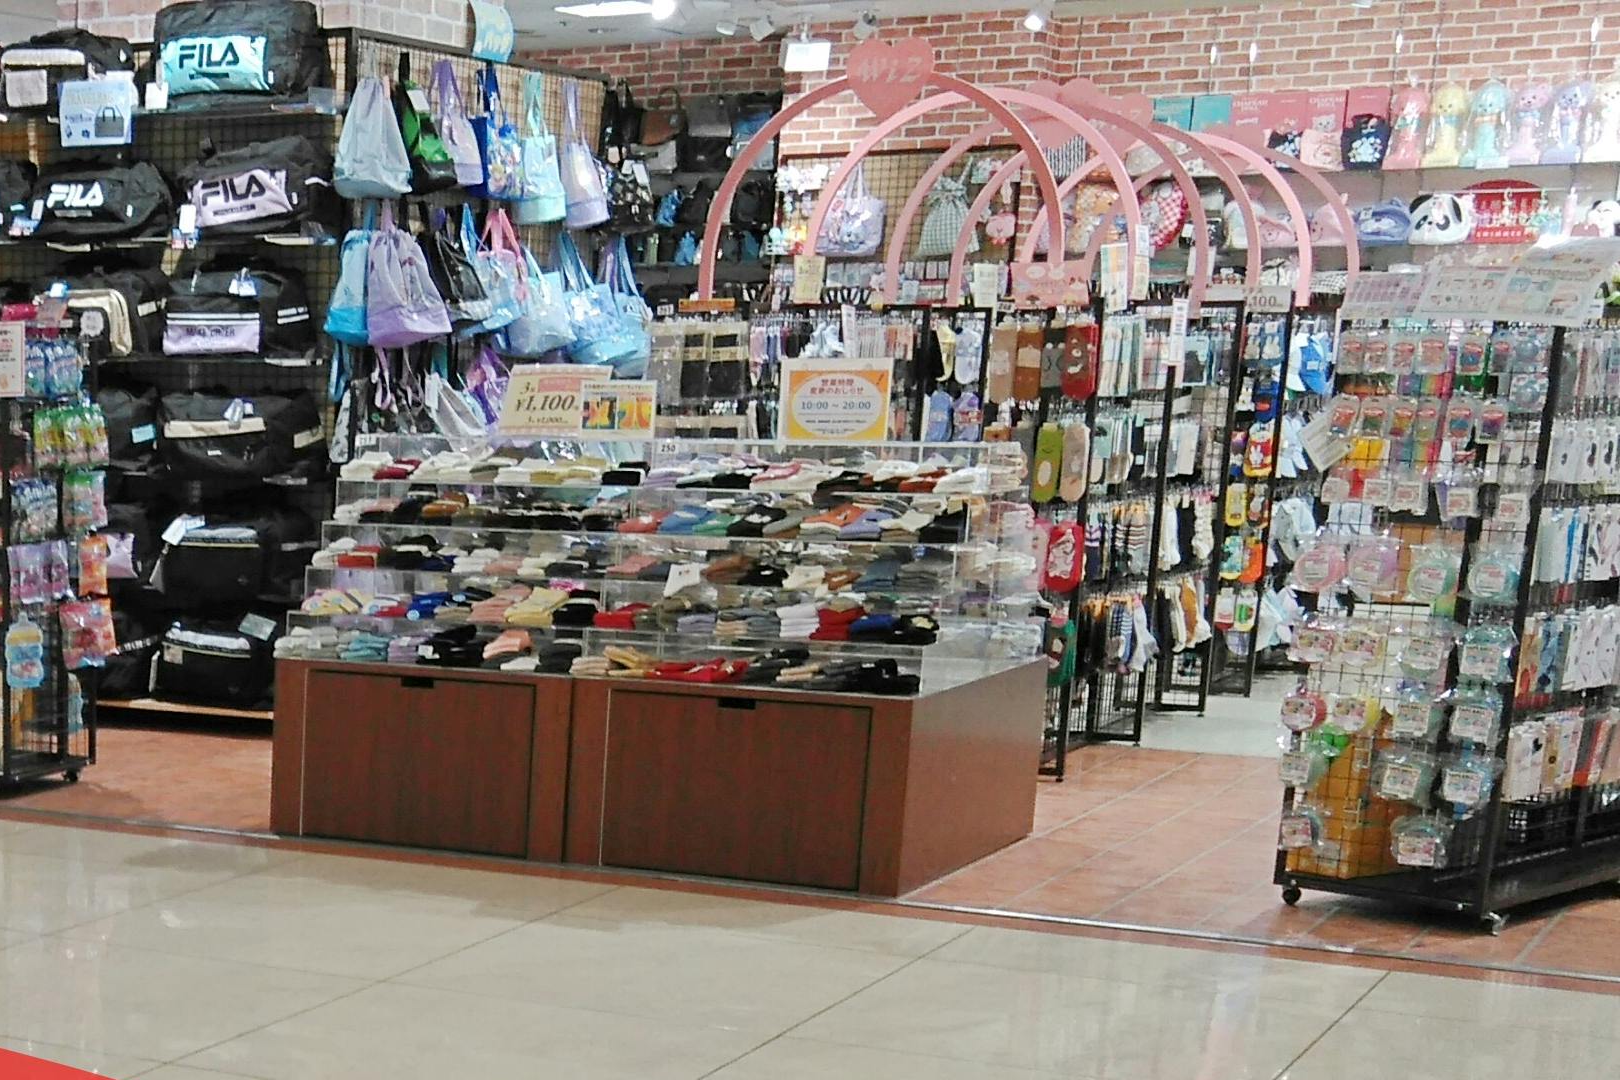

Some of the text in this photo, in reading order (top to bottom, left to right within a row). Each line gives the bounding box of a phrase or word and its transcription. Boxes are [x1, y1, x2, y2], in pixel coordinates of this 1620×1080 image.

[179, 42, 240, 69] FILA
[46, 181, 105, 209] FILA
[201, 174, 267, 207] FILA
[801, 401, 829, 410] 10:00
[842, 401, 872, 410] 20:00
